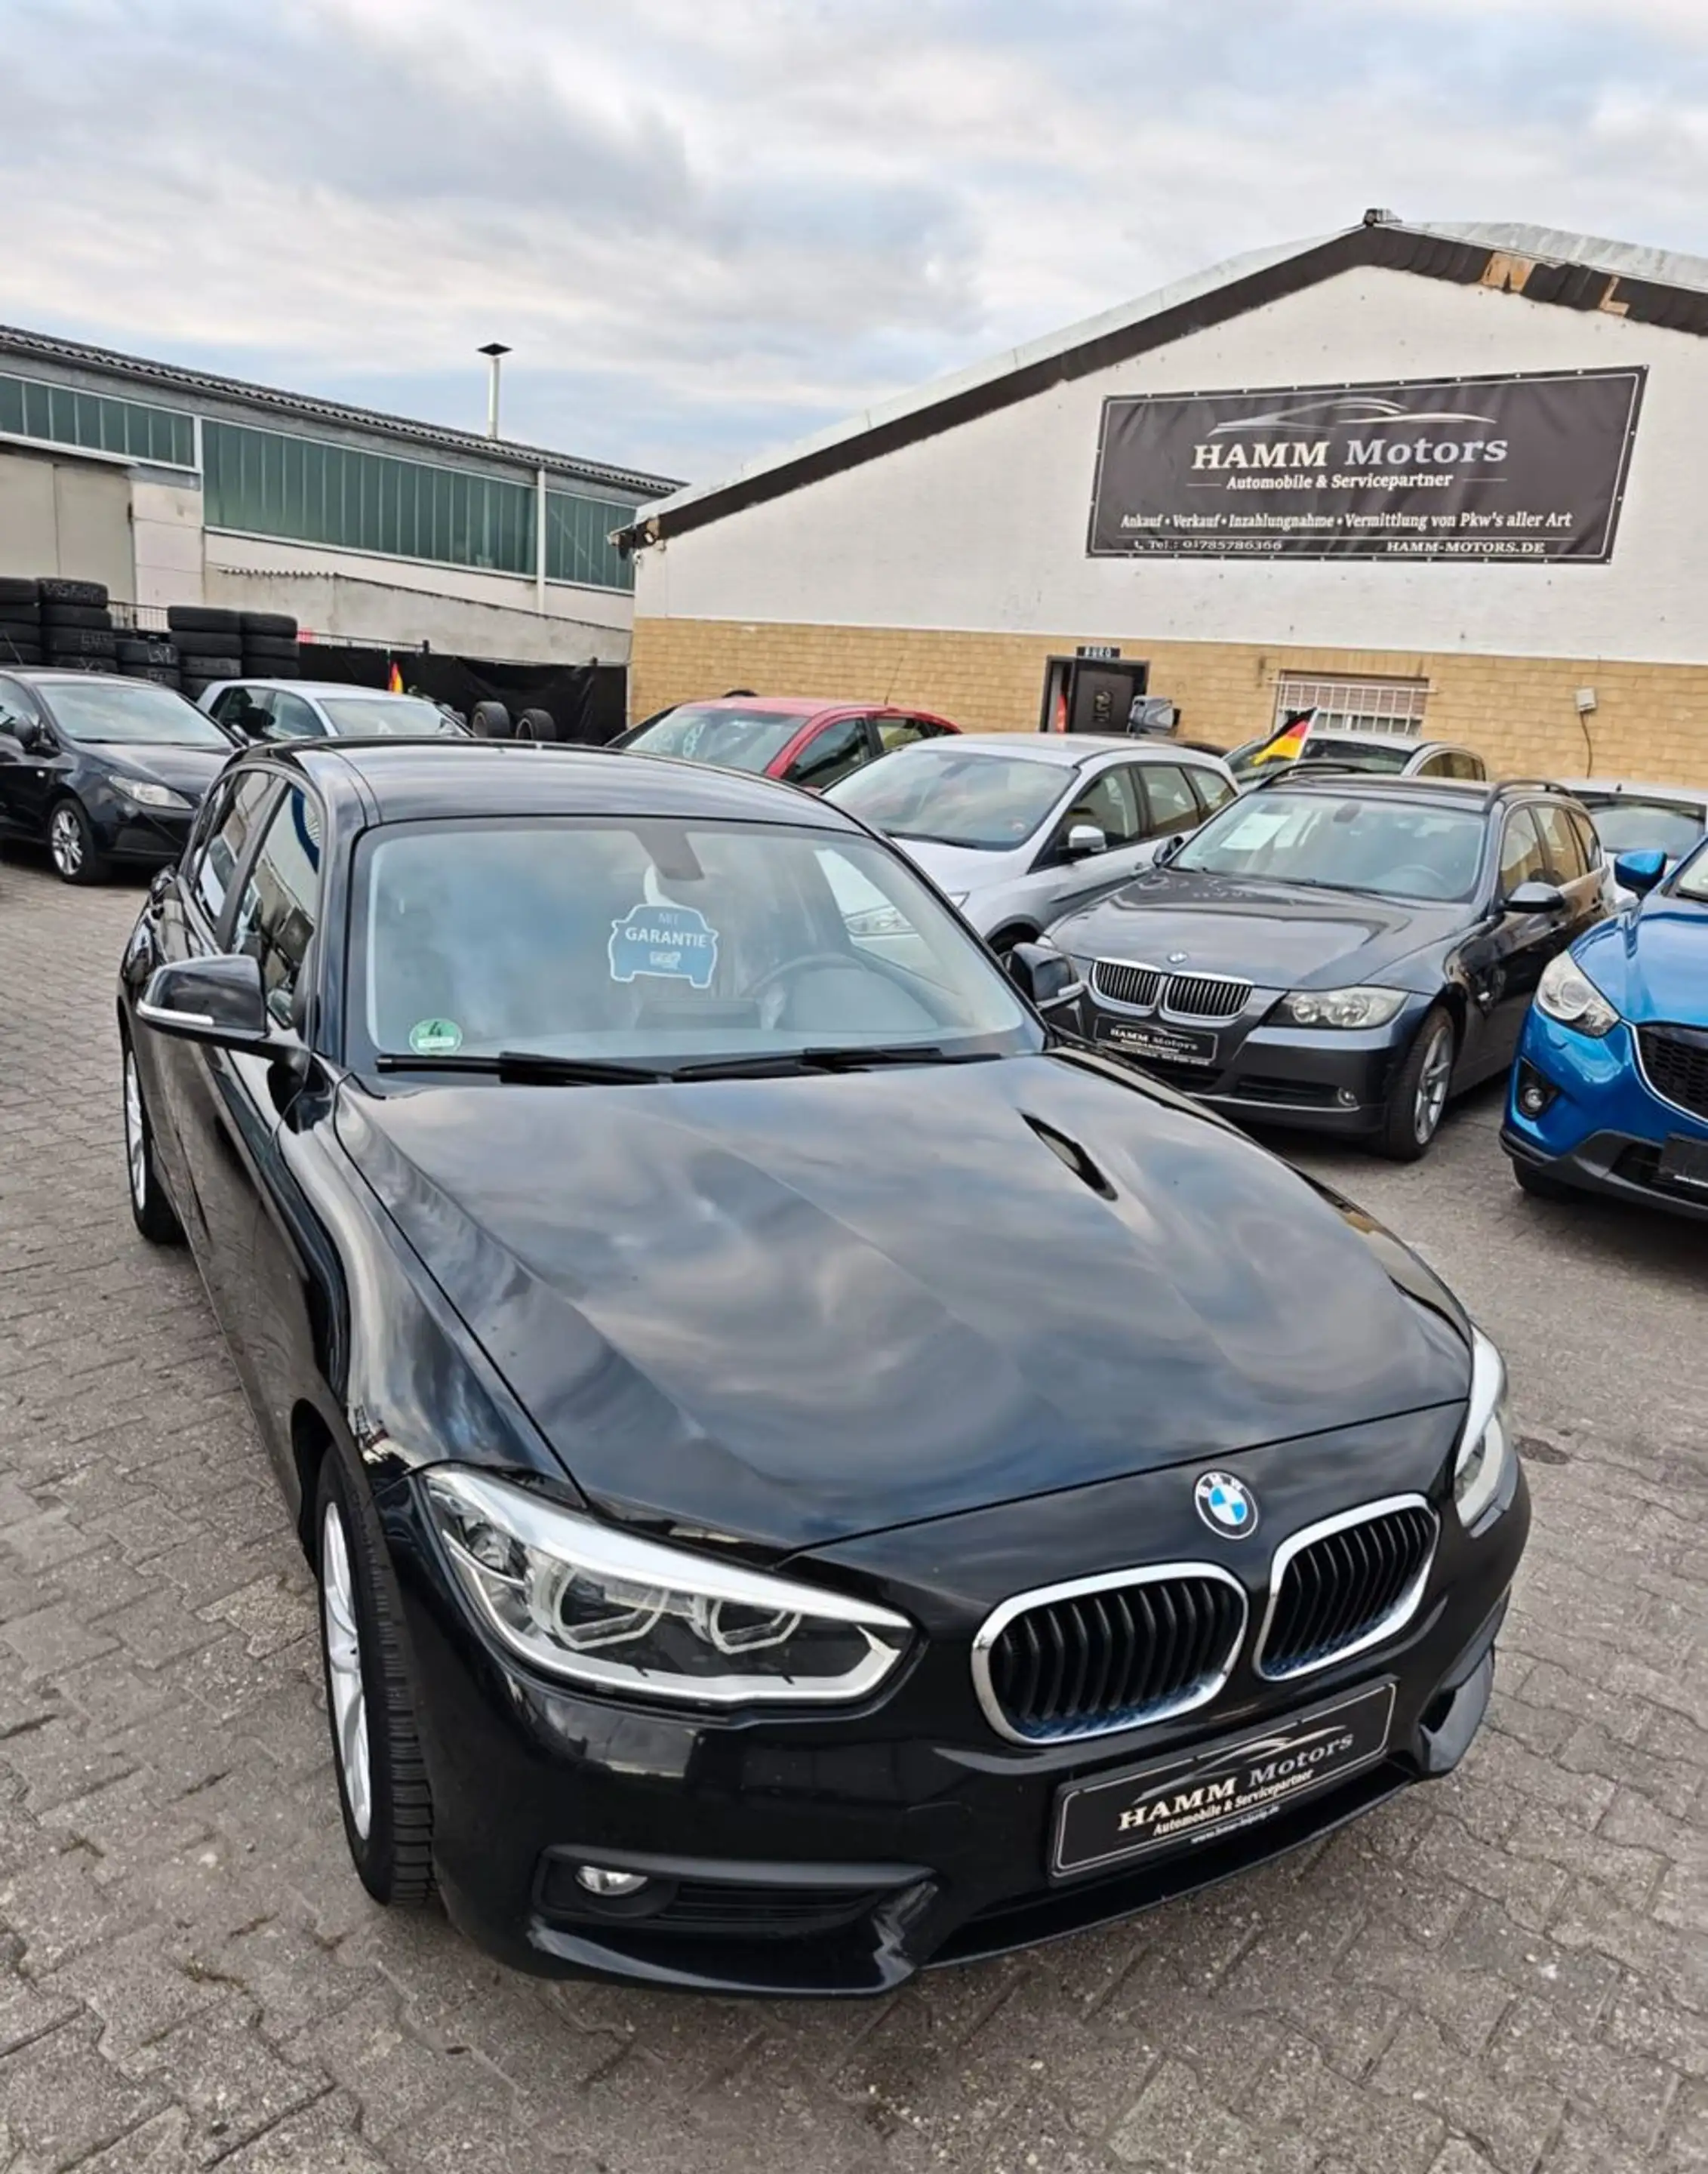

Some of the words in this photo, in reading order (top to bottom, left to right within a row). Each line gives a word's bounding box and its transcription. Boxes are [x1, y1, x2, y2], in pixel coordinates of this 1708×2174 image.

[1191, 441, 1331, 470] HAMM
[1343, 438, 1508, 466] Motors
[1226, 475, 1313, 491] Automobile
[1316, 475, 1327, 488] &
[1331, 473, 1454, 491] Servicepartner
[1121, 513, 1164, 528] Ankauf
[1173, 513, 1221, 528] Verkauf
[1228, 513, 1334, 532] Inzahlungnahme
[1344, 512, 1429, 531] Vermittlung
[1431, 515, 1457, 528] von
[1459, 511, 1504, 528] Pkw's
[1506, 511, 1544, 528] aller
[1545, 511, 1574, 528] Art
[1386, 541, 1546, 554] HAMM-MOTORS.DE
[624, 926, 709, 948] GARANTIE
[1109, 1027, 1149, 1042] HAMM
[1153, 1036, 1199, 1051] Motors
[1117, 1776, 1239, 1831] HAMM
[1247, 1733, 1354, 1788] Motors
[1152, 1804, 1222, 1837] Automobile
[1223, 1799, 1235, 1812] &
[1235, 1769, 1315, 1809] Servicepartner
